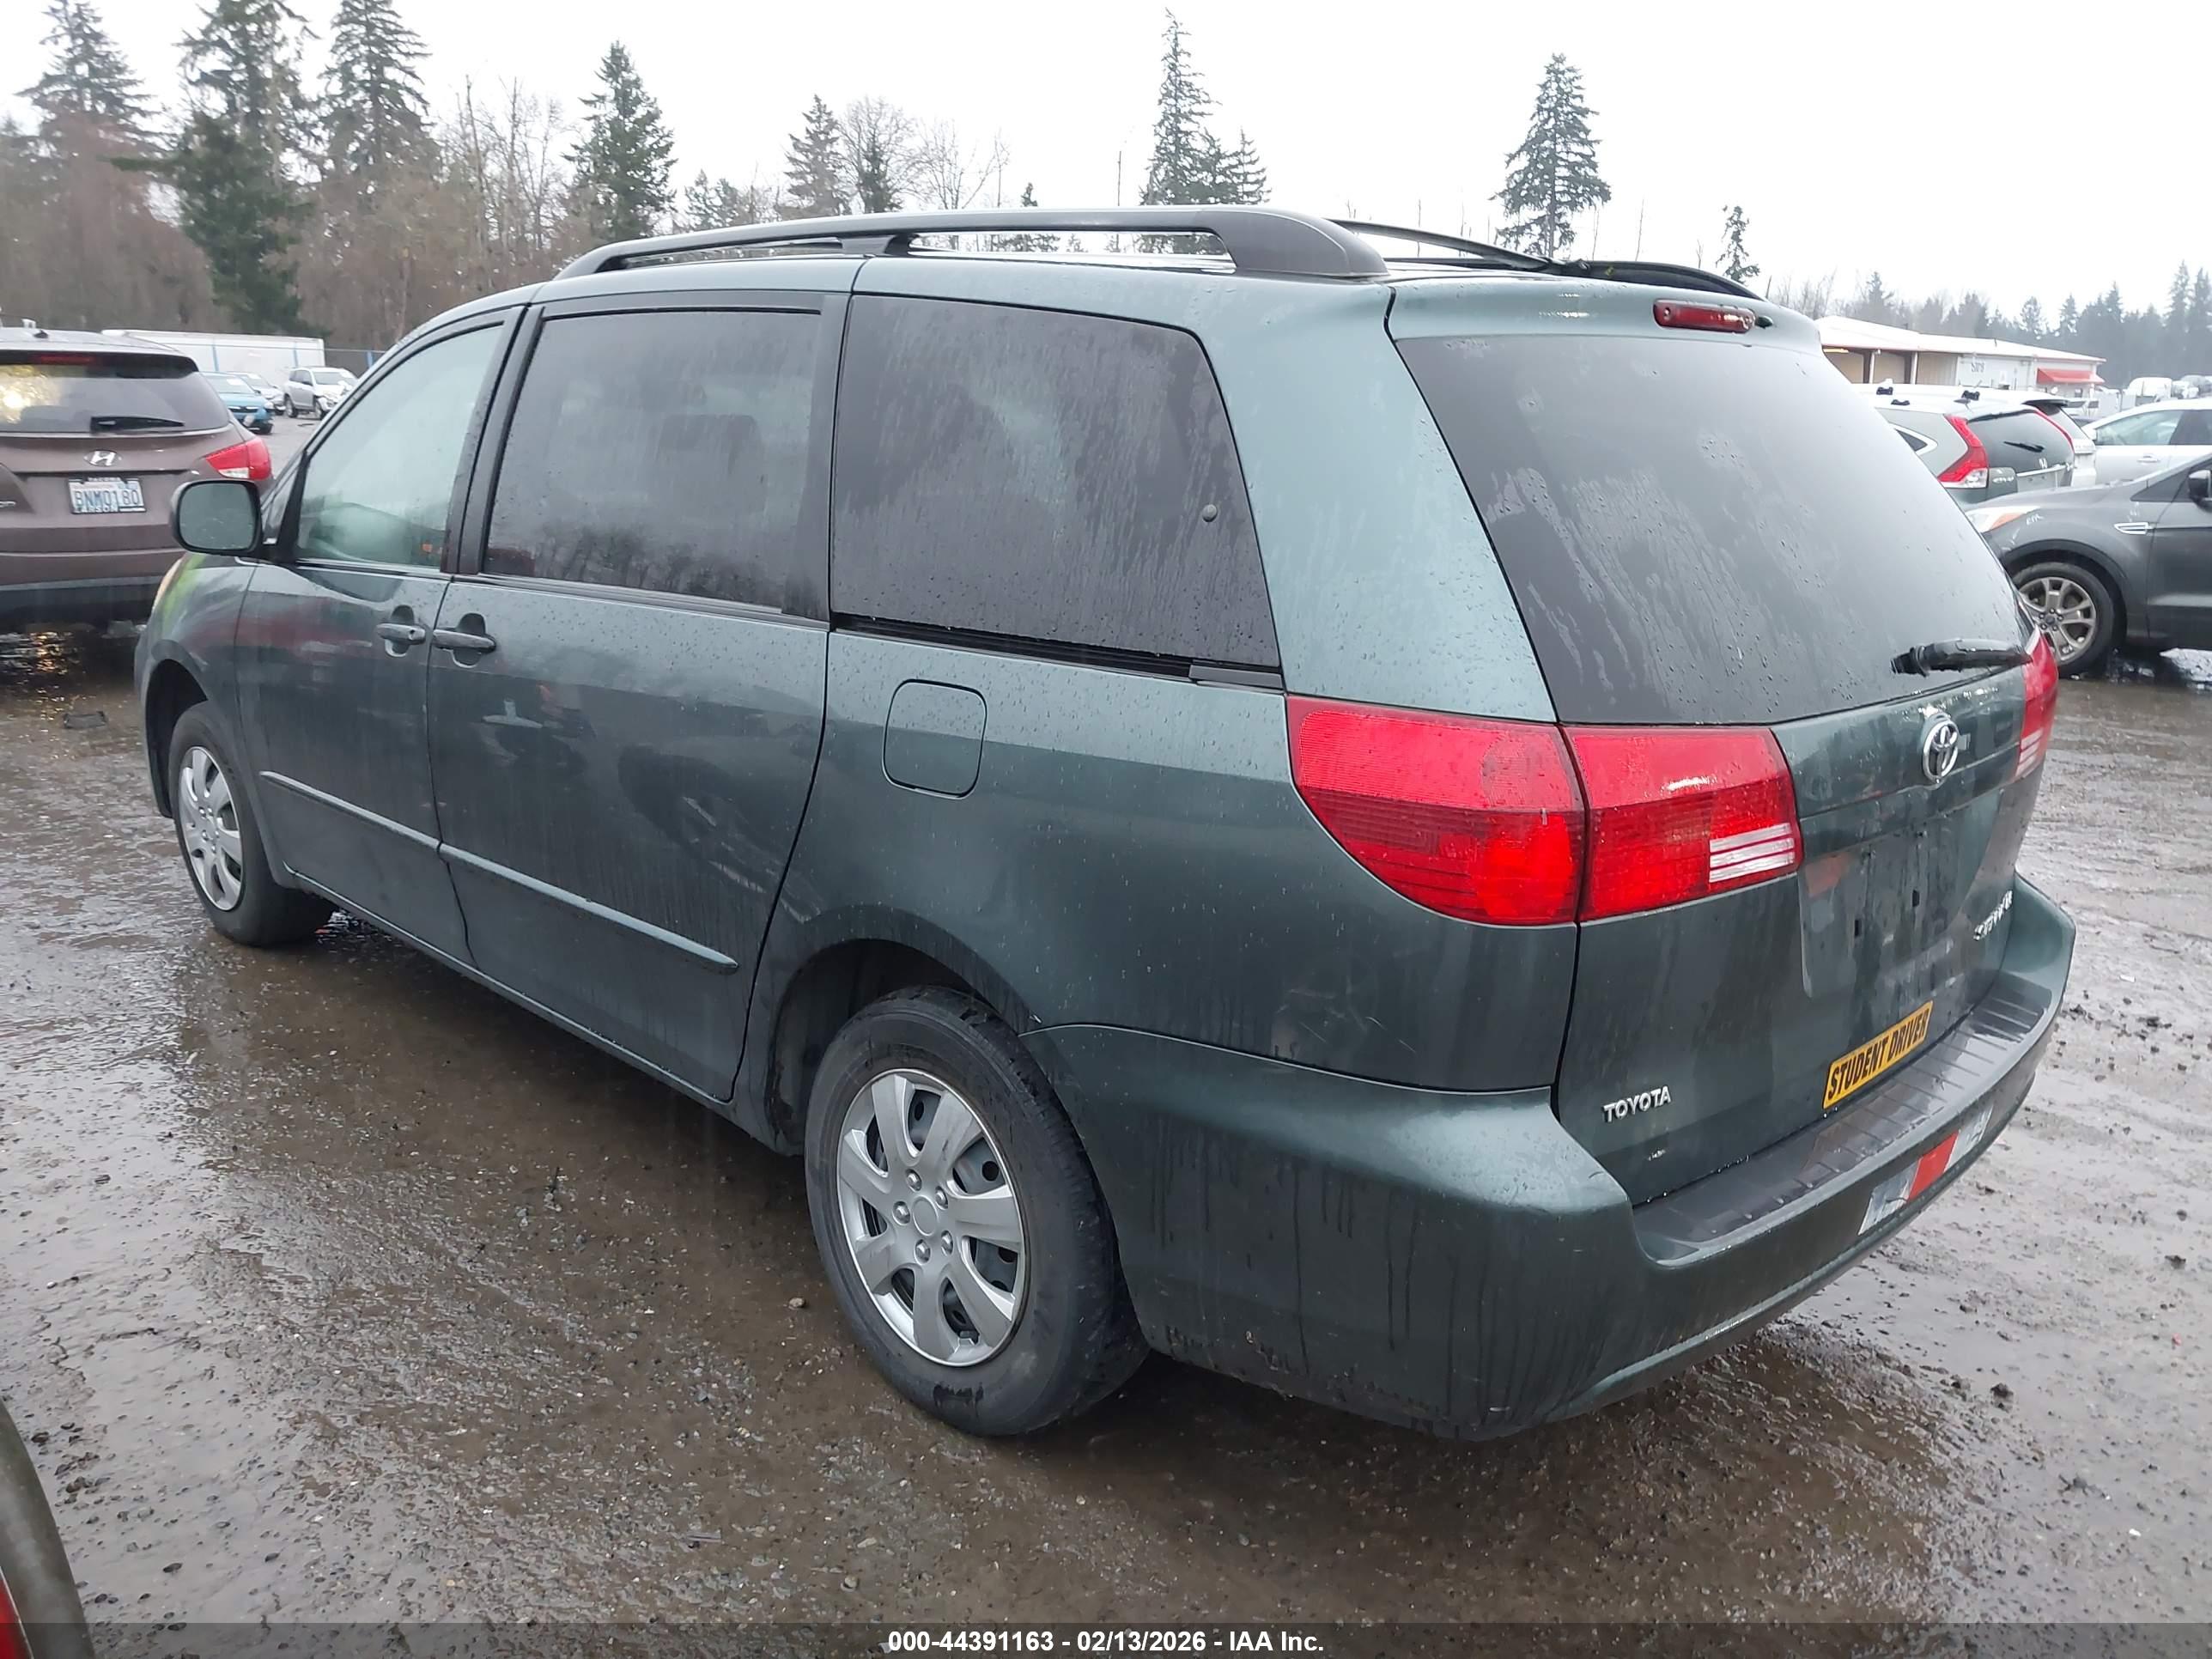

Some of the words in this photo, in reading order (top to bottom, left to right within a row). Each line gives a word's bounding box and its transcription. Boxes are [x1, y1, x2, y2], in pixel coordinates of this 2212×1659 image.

[1827, 1036, 1890, 1101] STUDENT
[1887, 1008, 1930, 1063] DRIVER
[1602, 1085, 1672, 1123] TOYOTA
